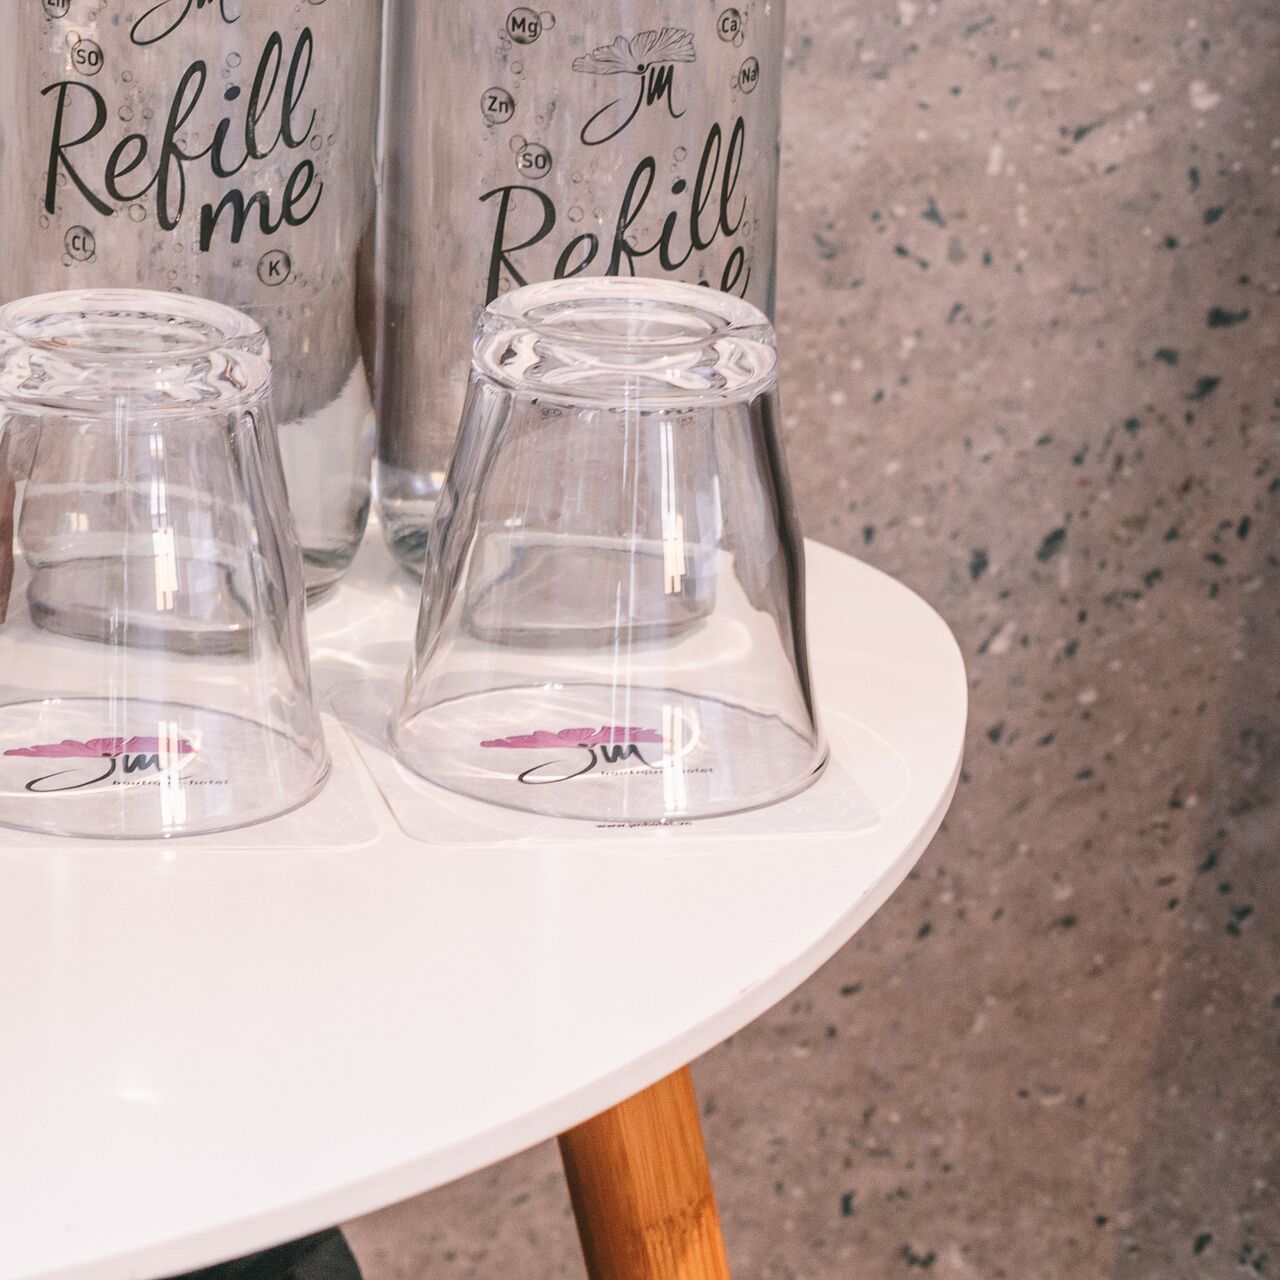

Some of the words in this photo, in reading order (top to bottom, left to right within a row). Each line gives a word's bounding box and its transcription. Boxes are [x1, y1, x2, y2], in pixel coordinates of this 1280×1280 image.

[511, 18, 538, 38] Mg
[721, 18, 738, 33] Ca
[76, 48, 99, 66] SO
[742, 67, 757, 83] Na
[487, 96, 509, 114] Zn
[41, 27, 316, 230] Refill
[521, 152, 547, 170] SO
[200, 159, 323, 251] me
[268, 259, 281, 277] K
